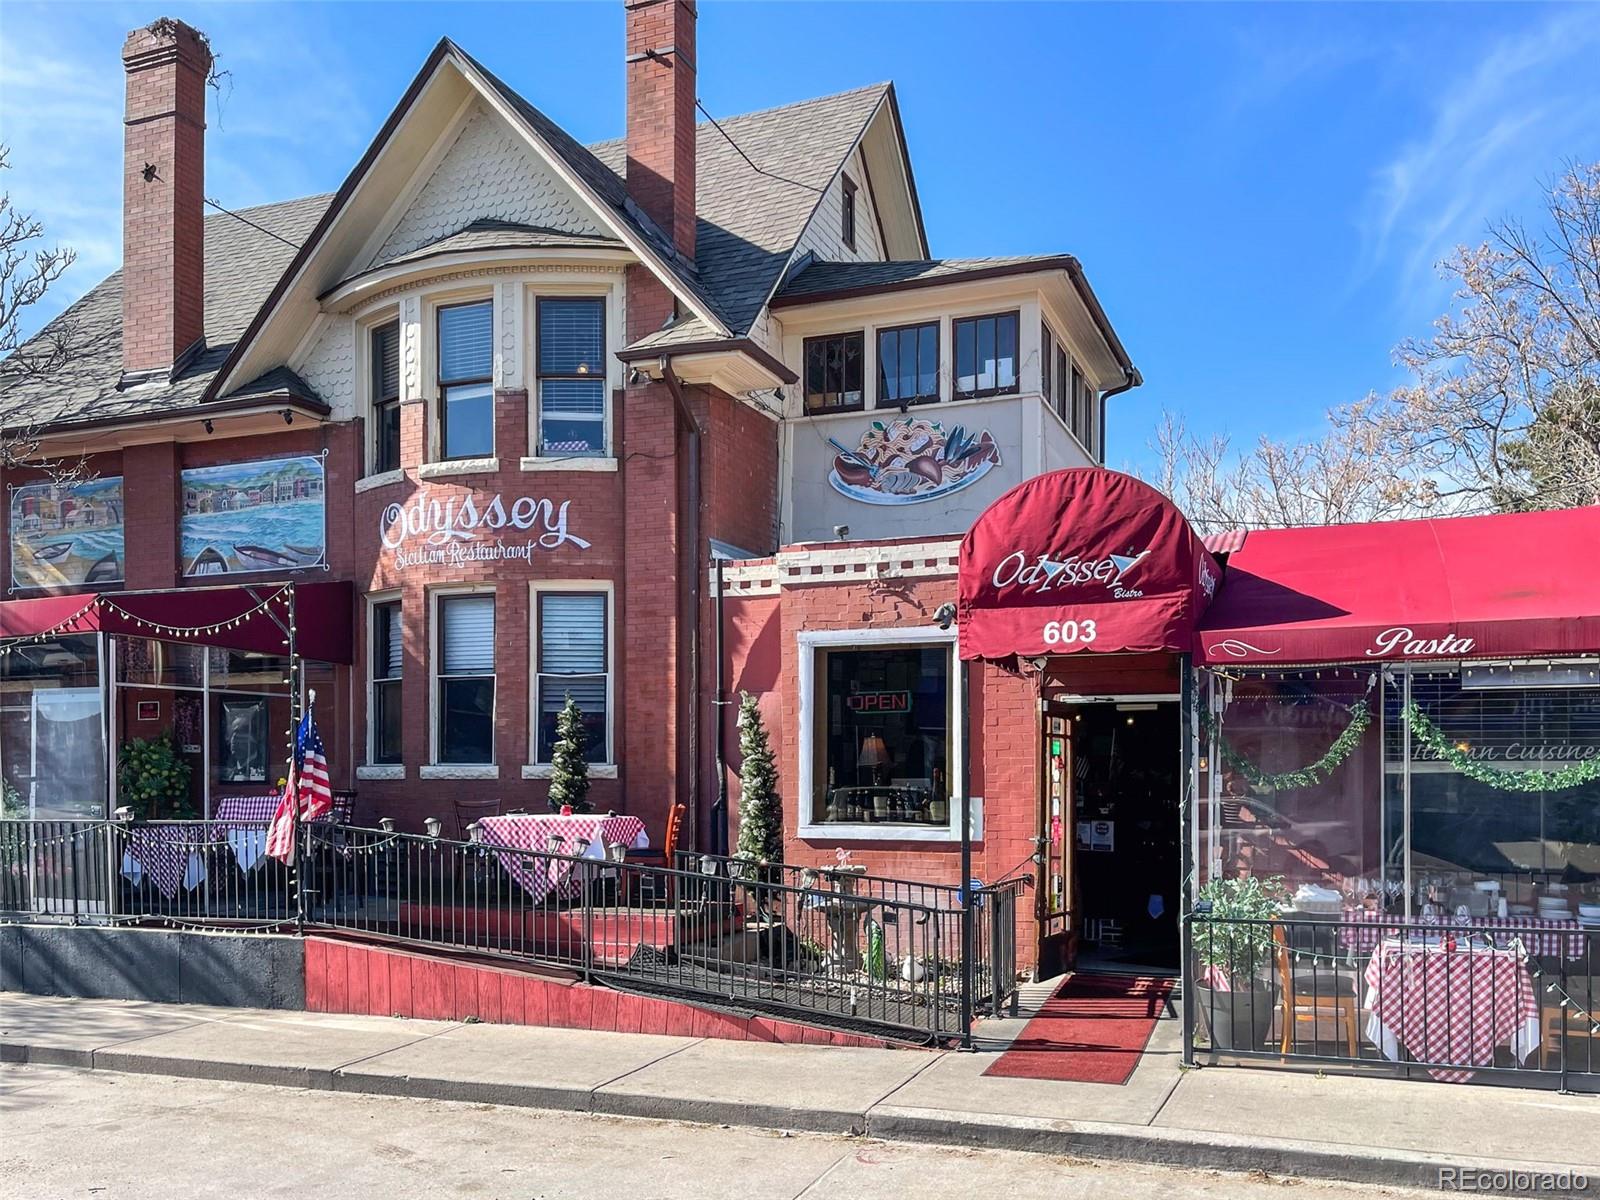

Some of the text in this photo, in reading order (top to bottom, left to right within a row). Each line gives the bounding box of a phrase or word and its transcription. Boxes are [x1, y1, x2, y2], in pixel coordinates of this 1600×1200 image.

[380, 493, 592, 549] Odyssey
[394, 538, 537, 570] Sicilian Restaurant
[1113, 588, 1143, 599] Bistro
[1043, 619, 1097, 643] 603
[1366, 627, 1475, 656] Pasta
[847, 694, 906, 709] OPEN
